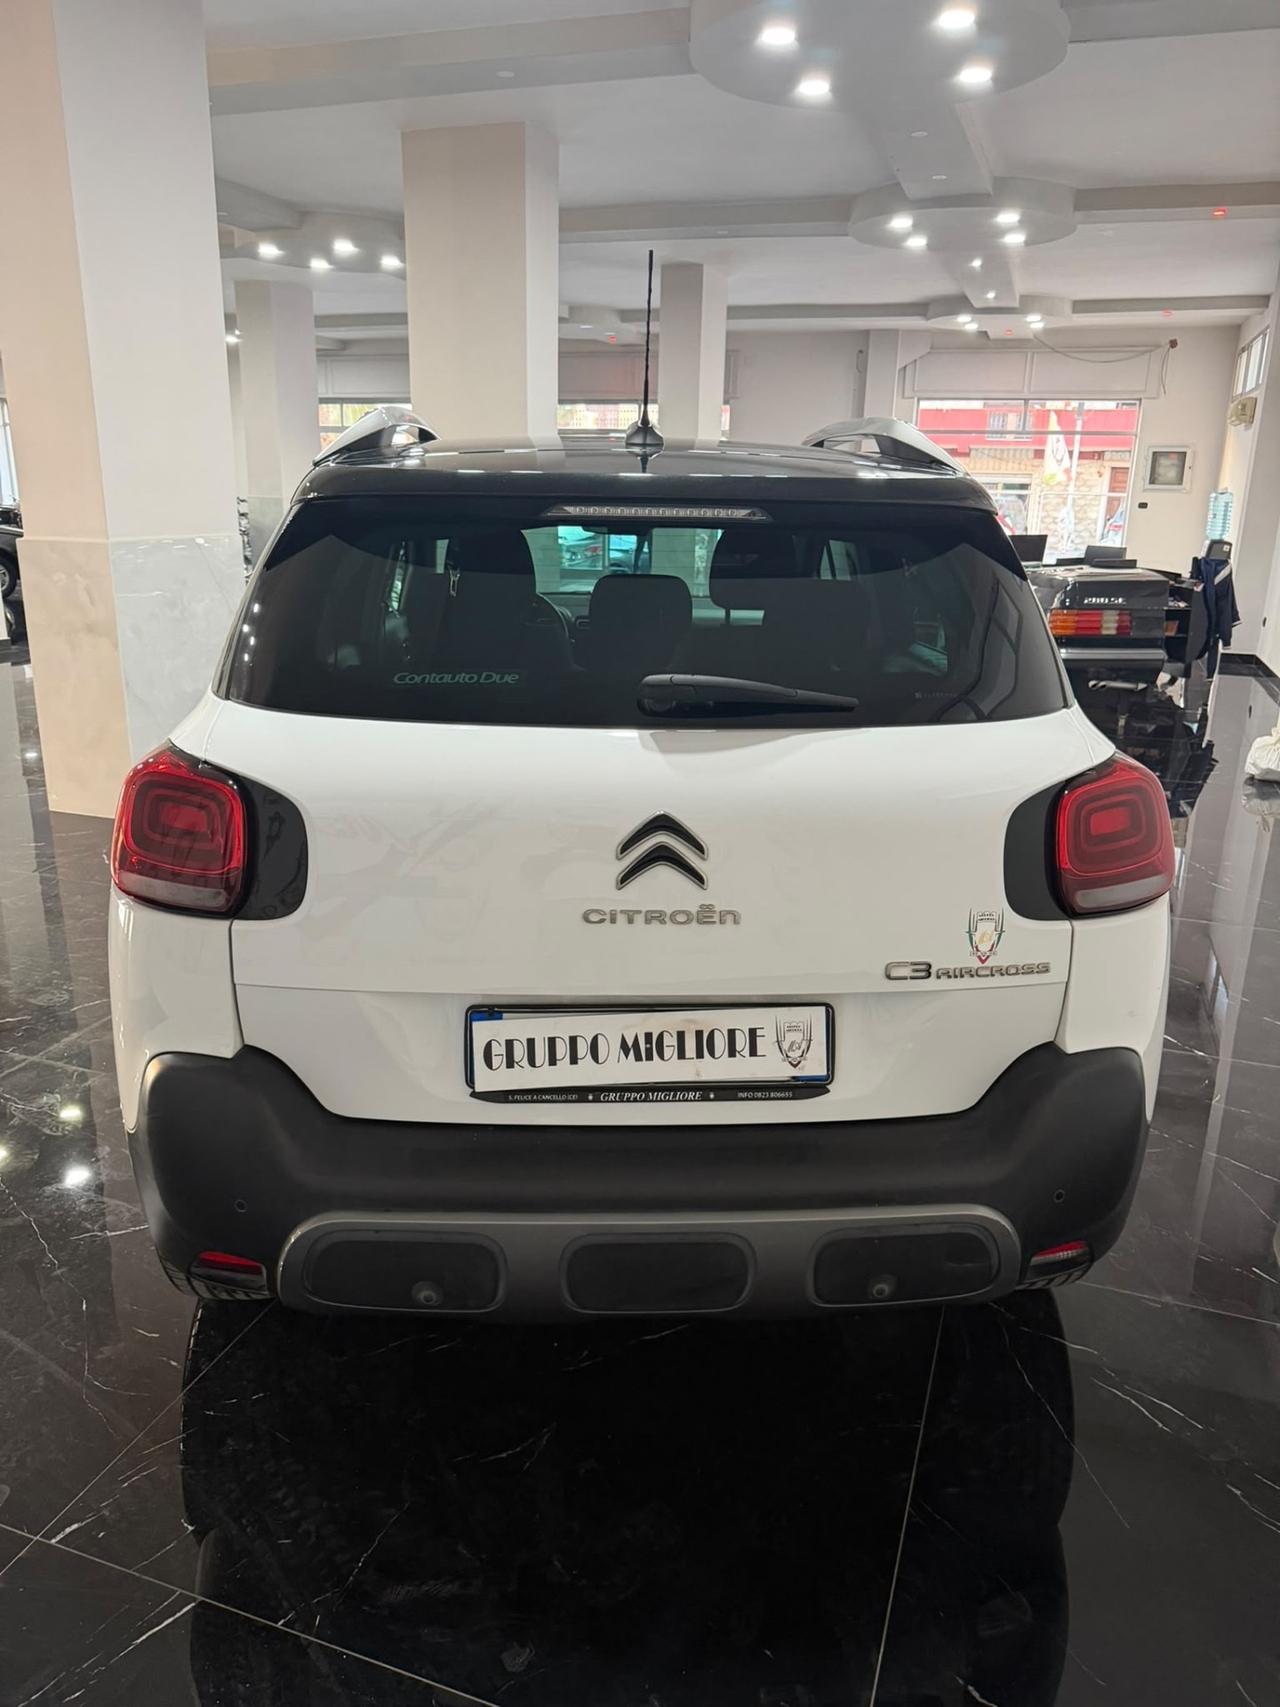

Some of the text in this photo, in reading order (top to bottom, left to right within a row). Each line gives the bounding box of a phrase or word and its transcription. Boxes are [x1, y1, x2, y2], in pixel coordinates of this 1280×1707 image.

[393, 672, 519, 684] Contauto Due
[885, 961, 1051, 981] C3 AIRCROSS
[483, 1027, 766, 1071] GRUPPO MIGLIORE
[600, 1090, 703, 1102] GRUPPO MIGLIORE
